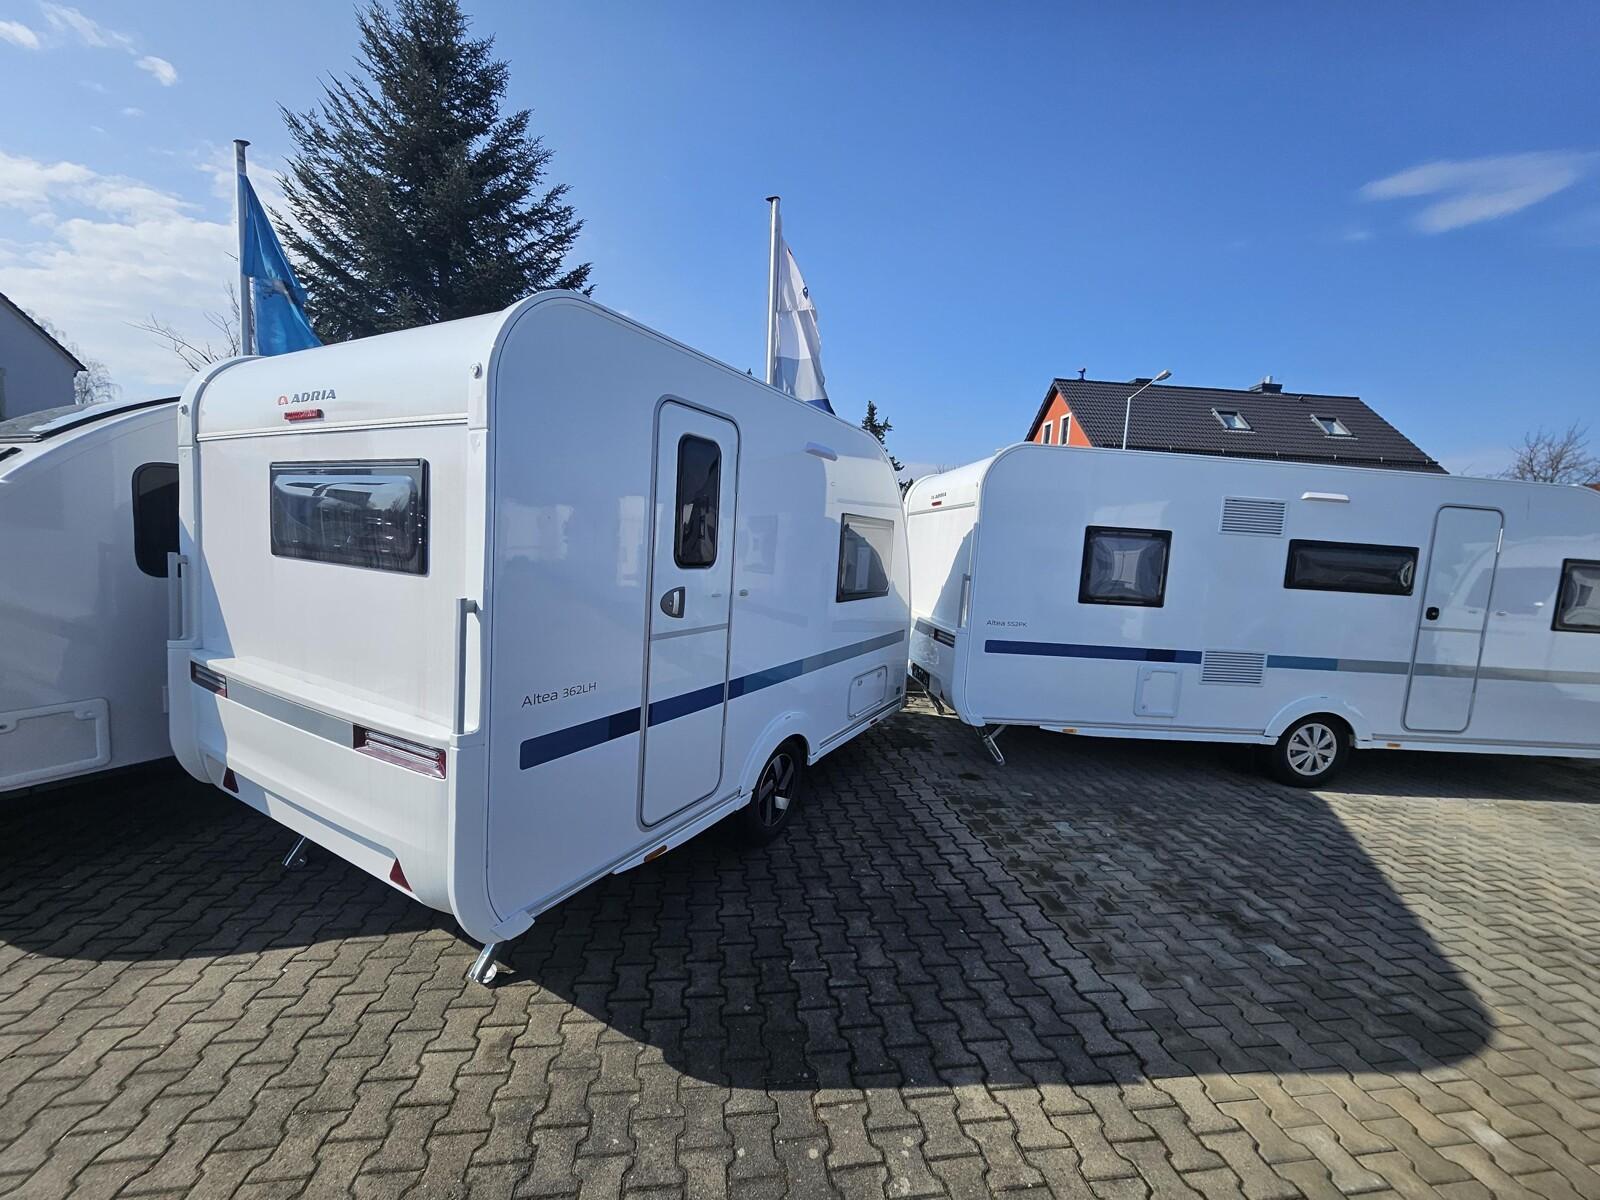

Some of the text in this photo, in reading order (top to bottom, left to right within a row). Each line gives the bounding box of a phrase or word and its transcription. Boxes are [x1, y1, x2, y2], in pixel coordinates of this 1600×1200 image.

[291, 389, 336, 403] ADRIA
[521, 681, 597, 708] Altea 362LH
